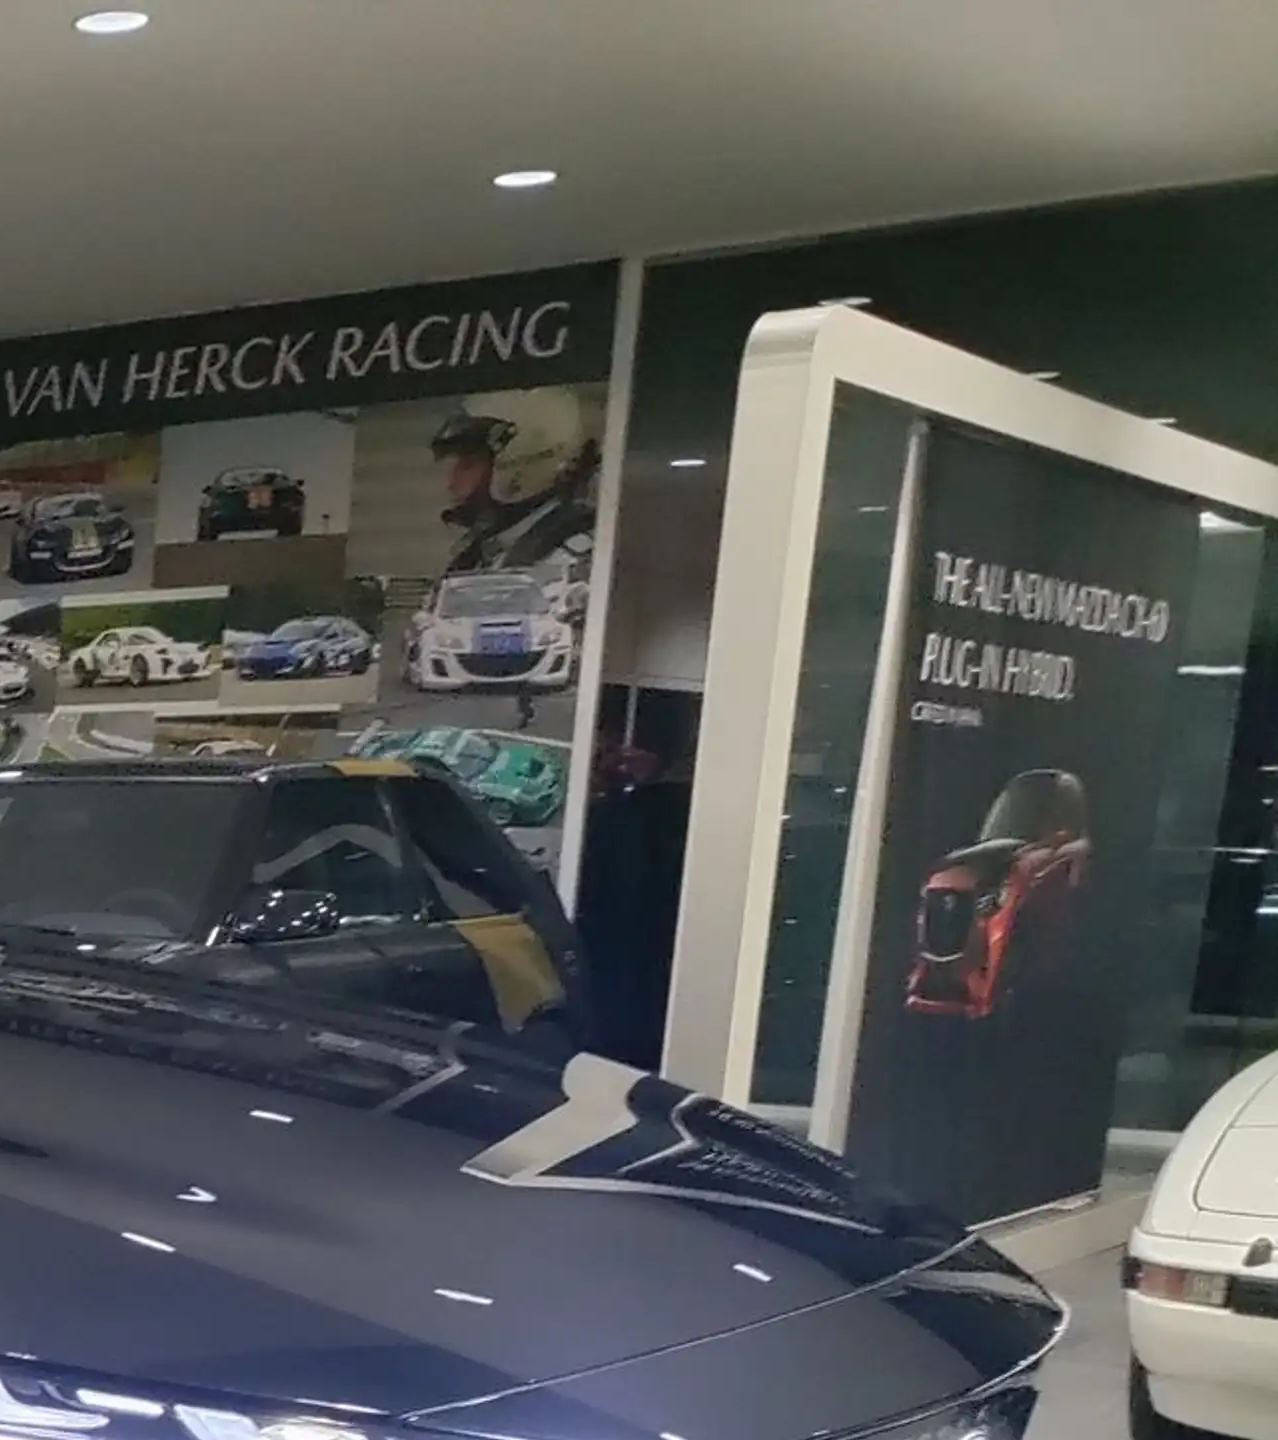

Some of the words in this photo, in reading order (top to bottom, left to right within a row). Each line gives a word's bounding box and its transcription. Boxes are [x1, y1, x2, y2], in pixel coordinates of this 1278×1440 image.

[3, 361, 104, 418] VAN
[123, 332, 314, 402] HERCK
[326, 301, 571, 381] RACING
